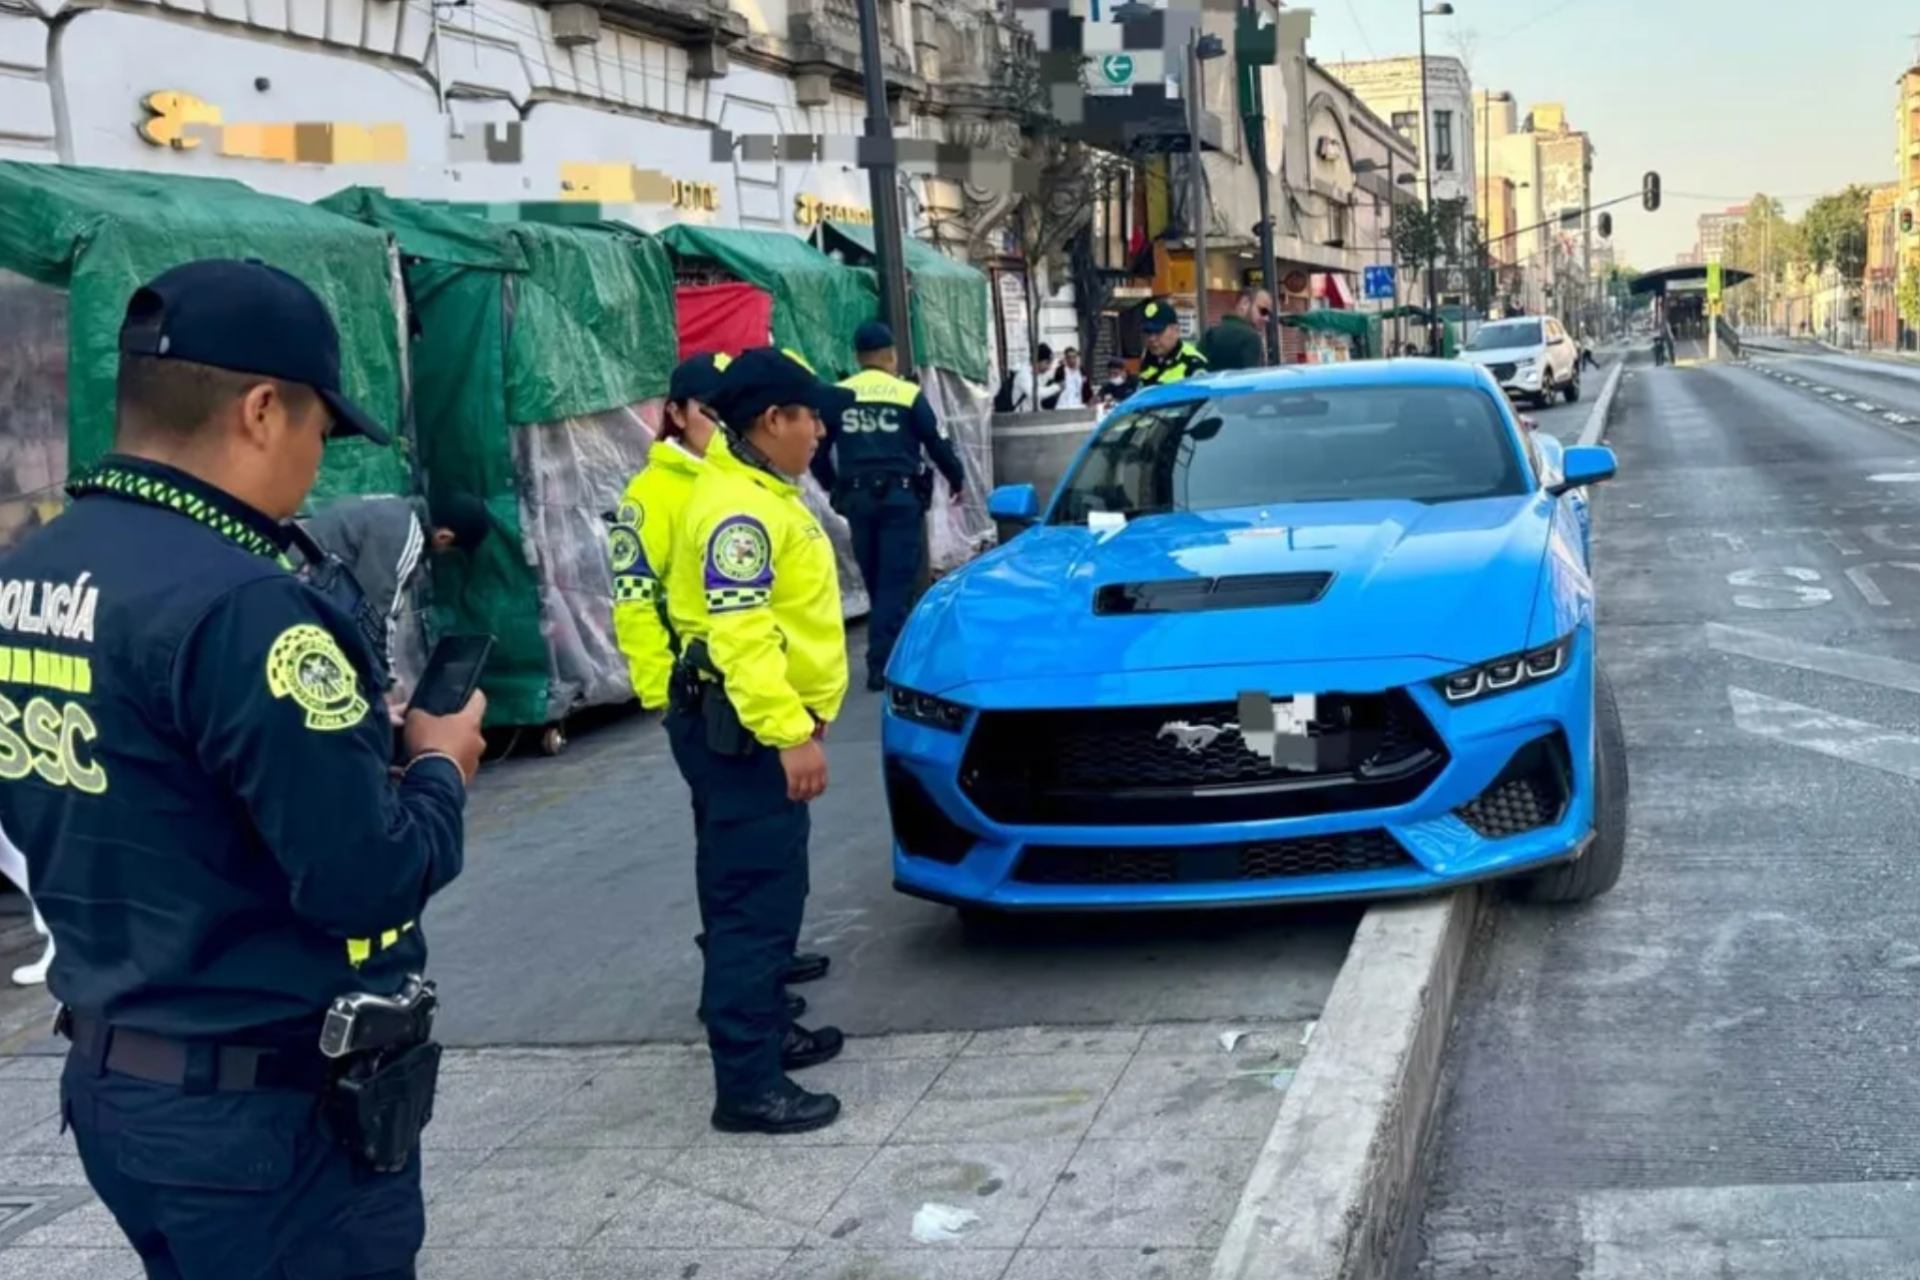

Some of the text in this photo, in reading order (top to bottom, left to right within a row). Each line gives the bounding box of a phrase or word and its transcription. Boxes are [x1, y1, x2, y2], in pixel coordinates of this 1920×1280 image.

[841, 407, 900, 433] SSC
[0, 571, 99, 642] OLICÍA
[0, 693, 108, 794] SSC
